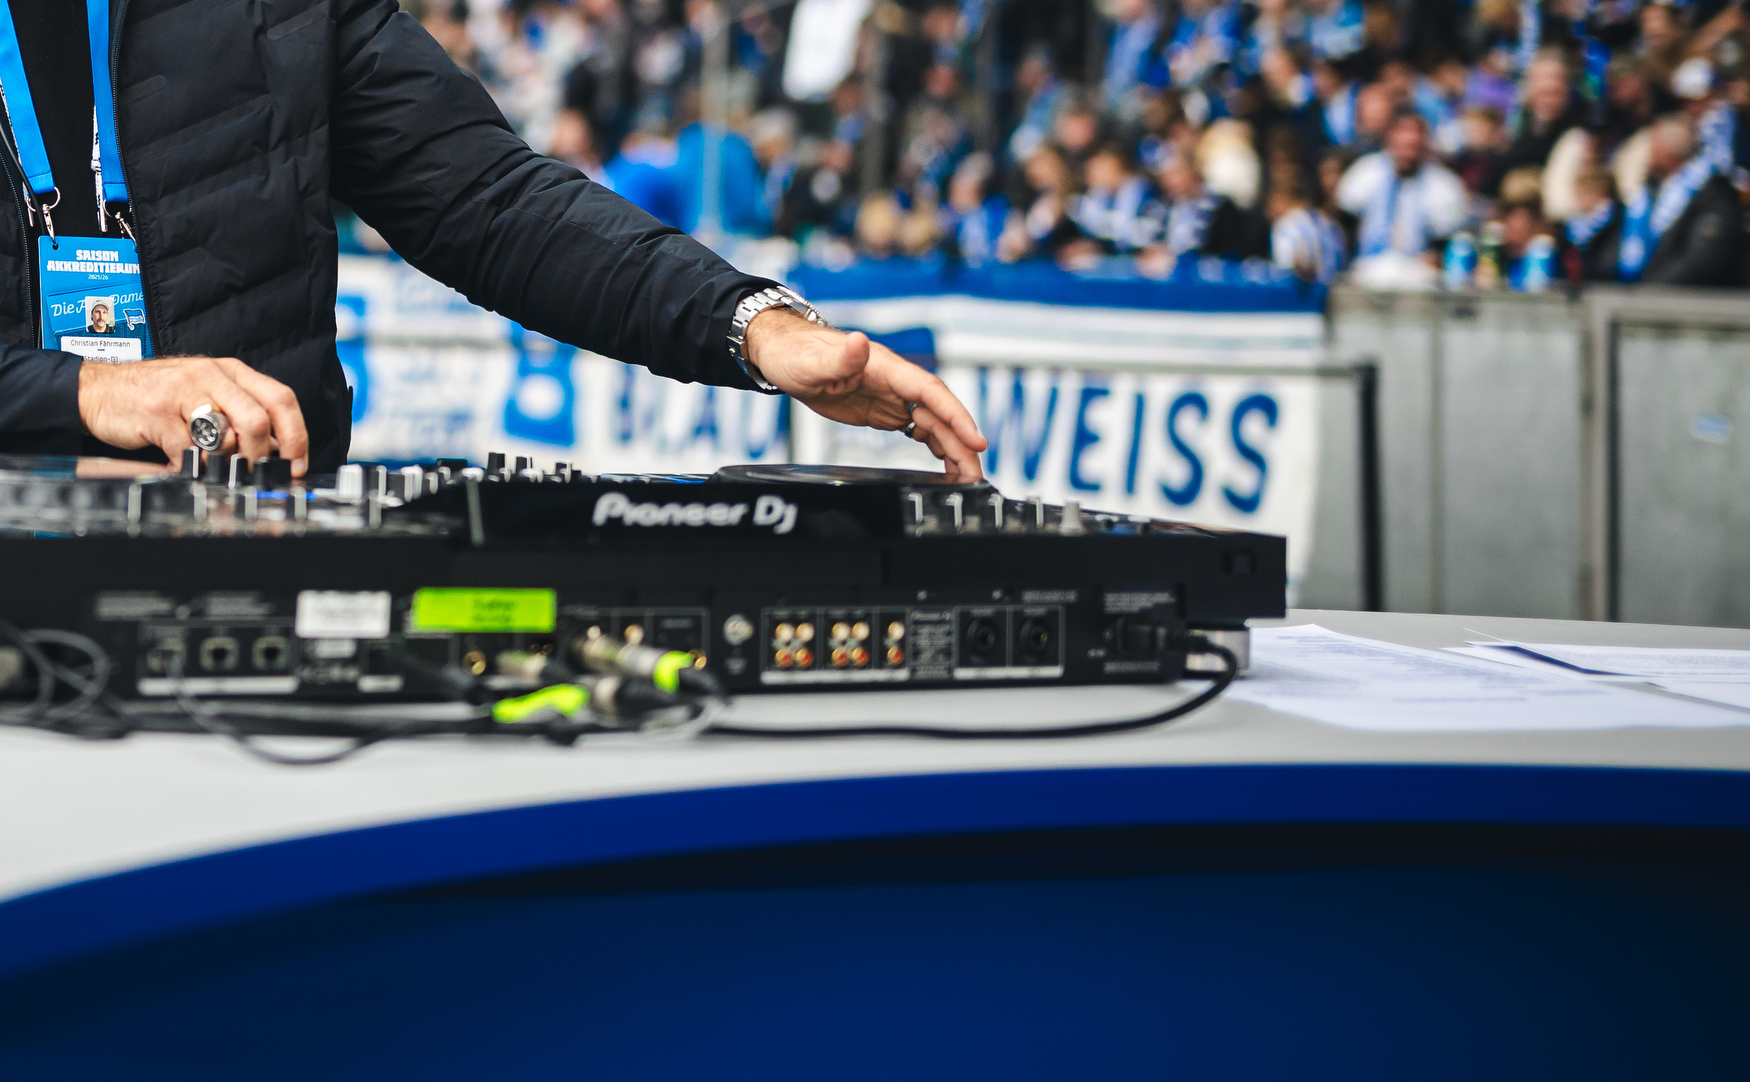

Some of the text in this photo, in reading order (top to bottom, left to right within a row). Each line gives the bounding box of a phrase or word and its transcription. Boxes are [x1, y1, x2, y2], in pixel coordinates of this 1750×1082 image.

[76, 249, 119, 262] SAISON
[47, 260, 140, 274] AKKREDITIERUN
[50, 302, 75, 317] Die
[70, 339, 98, 347] Christian
[976, 365, 1278, 514] WEISS
[592, 492, 749, 527] Pioneer
